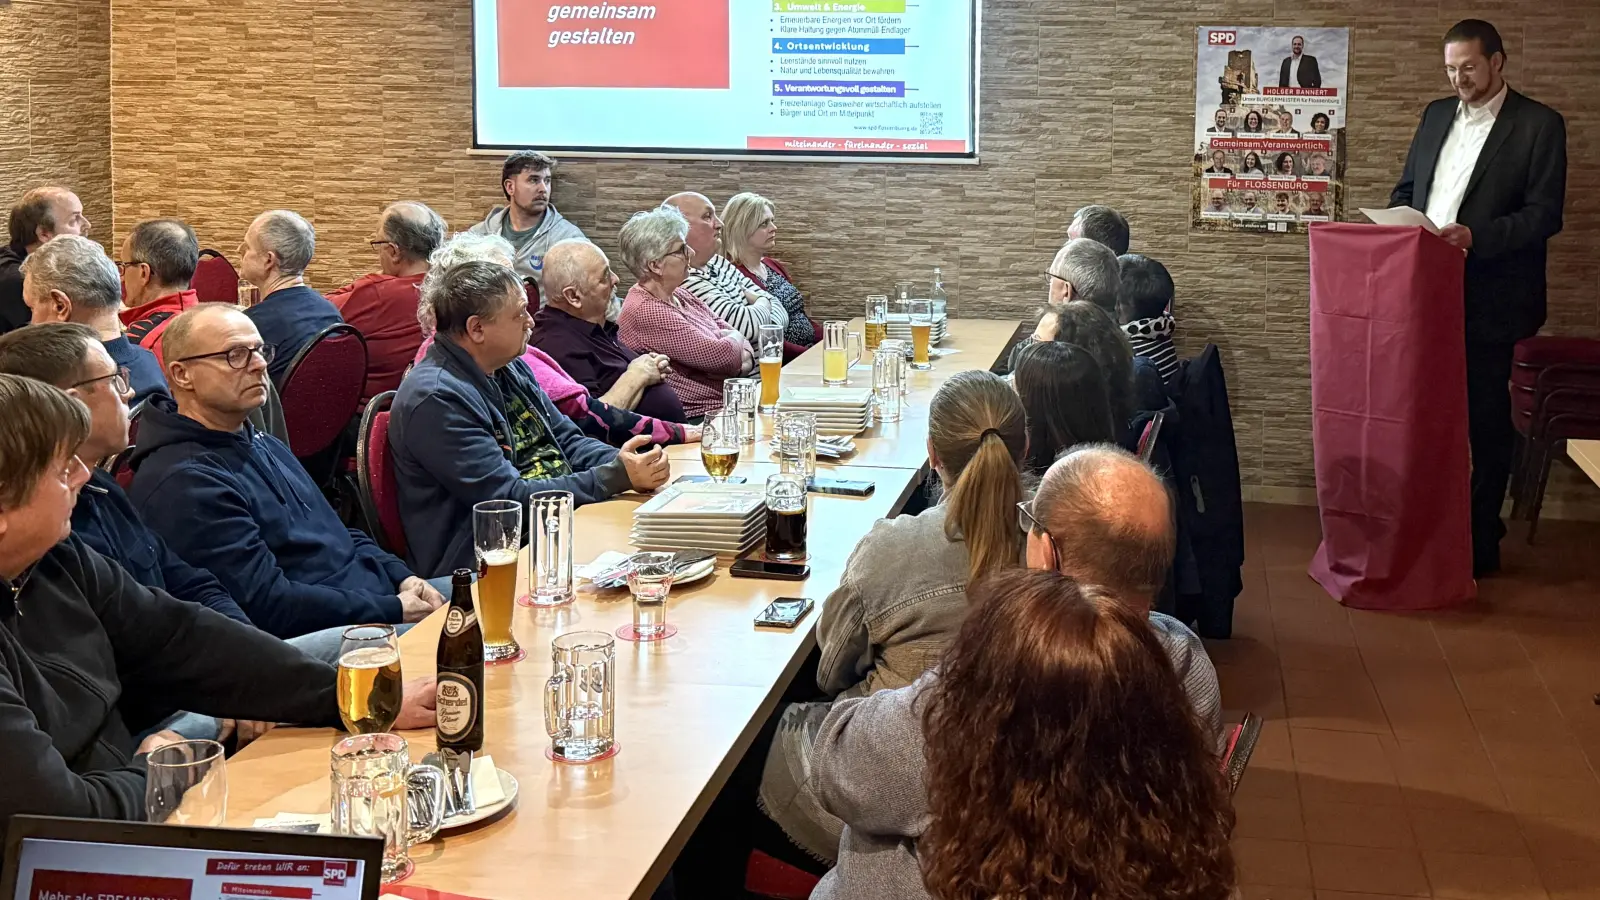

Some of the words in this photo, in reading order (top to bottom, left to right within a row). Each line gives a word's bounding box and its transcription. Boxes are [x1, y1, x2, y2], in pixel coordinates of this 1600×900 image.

[547, 1, 656, 23] gemeinsam
[774, 2, 783, 11] 3.
[787, 2, 821, 11] Umwelt
[823, 3, 831, 11] &
[832, 3, 866, 12] Energie
[780, 15, 821, 24] Erneuerbare
[822, 15, 852, 25] Energien
[865, 15, 876, 24] Ort
[877, 15, 902, 24] fördern
[780, 25, 798, 33] Klare
[798, 25, 824, 35] Haltung
[825, 27, 846, 35] gegen
[881, 26, 911, 36] Endlager
[547, 26, 636, 48] gestalten
[1209, 32, 1236, 44] SPD
[773, 42, 783, 50] 4.
[786, 41, 870, 53] Ortsentwicklung
[780, 57, 816, 65] Leerstände
[817, 57, 842, 65] sinnvoll
[843, 58, 867, 66] nutzen
[780, 67, 801, 75] Natur
[802, 67, 812, 75] und
[813, 66, 861, 76] Lebensqualität
[862, 67, 895, 76] bewahren
[774, 84, 783, 92] 5.
[784, 83, 859, 95] Verantwortungsvoll
[860, 86, 897, 95] gestalten
[1266, 88, 1294, 96] HOLGER
[1295, 89, 1329, 97] BANNERT
[780, 99, 825, 109] Freizeitanlage
[865, 101, 908, 110] wirtschaftlich
[780, 109, 802, 118] Bürger
[839, 110, 875, 119] Mittelpunkt
[784, 140, 837, 150] miteinander
[844, 140, 895, 152] füreinander
[902, 141, 929, 150] sozial
[1227, 180, 1241, 188] Für
[216, 861, 240, 871] Dafür
[275, 863, 294, 872] WIR
[323, 868, 346, 880] SPD
[232, 886, 273, 896] Miteinander
